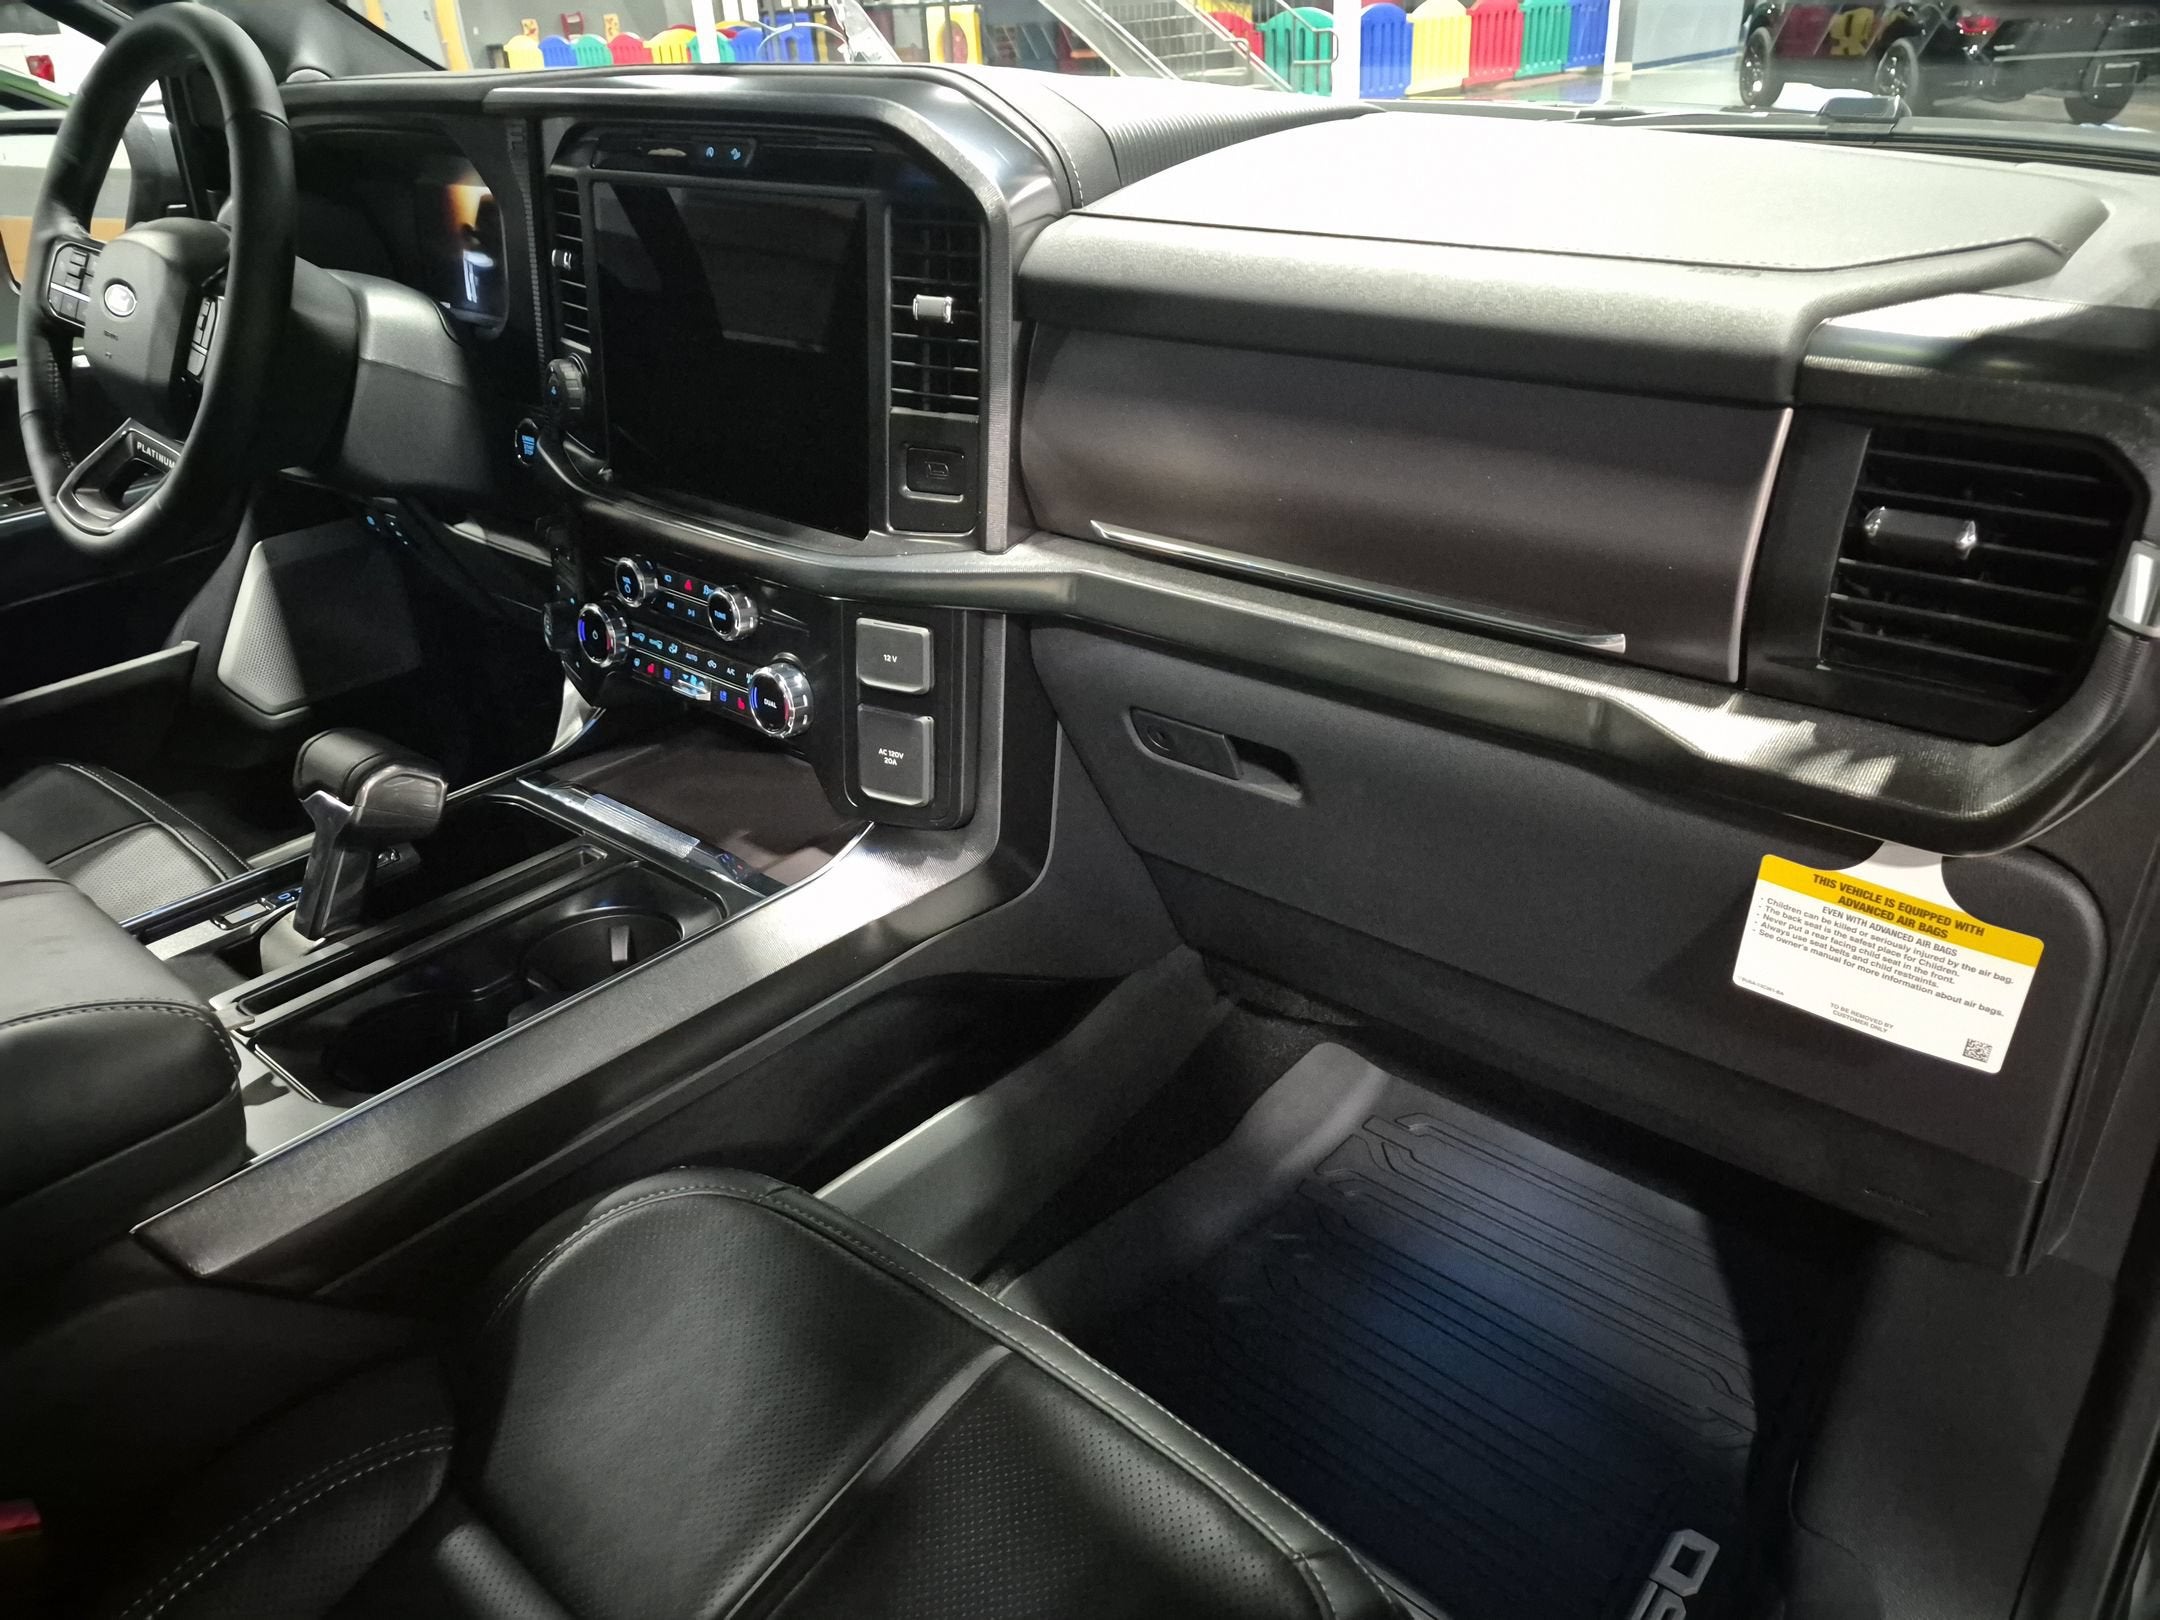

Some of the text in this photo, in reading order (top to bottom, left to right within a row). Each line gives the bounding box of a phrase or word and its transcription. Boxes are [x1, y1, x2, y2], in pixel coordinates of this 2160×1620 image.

[136, 441, 176, 469] PLATINUM
[883, 653, 892, 663] 12
[763, 697, 778, 709] DUAL
[878, 747, 905, 760] AC 120V
[883, 756, 898, 766] 20A
[1813, 874, 1985, 936] THIS VEHICLE IS EQUIPPED WITH
[1837, 896, 1948, 938] ADVANCED AIR BAGS
[1760, 922, 1790, 936] Always
[1792, 934, 1807, 942] use
[1809, 940, 1827, 949] seat
[1829, 945, 1849, 957] belts
[1851, 955, 1869, 964] and
[1870, 961, 1892, 972] child
[1763, 913, 1787, 926] Never
[1788, 924, 1802, 932] put
[1811, 932, 1829, 940] rear
[1830, 937, 1857, 952] facing
[1858, 948, 1880, 959] child
[1882, 956, 1901, 966] seat
[1903, 962, 1911, 970] in
[1913, 966, 1928, 975] the
[1765, 905, 1780, 915] The
[1782, 912, 1802, 923] back
[1804, 921, 1822, 930] seat
[1833, 930, 1847, 939] the
[1849, 936, 1876, 949] safest
[1877, 946, 1901, 957] place
[1903, 954, 1916, 962] for
[1767, 898, 1801, 915] Children
[1803, 912, 1819, 920] can
[1821, 916, 1831, 924] be
[1833, 921, 1857, 933] killed
[1870, 935, 1911, 952] seriously
[1913, 948, 1945, 963] injured
[1947, 959, 1959, 968] by
[1961, 963, 1976, 972] the
[1993, 973, 2013, 984] bag.
[1822, 906, 1957, 956] EVEN WITH ADVANCED AIR BAGS
[1759, 929, 1774, 939] See
[1810, 948, 1841, 963] manual
[1843, 959, 1855, 968] for
[1857, 965, 1880, 976] more
[1881, 973, 1933, 994] information
[1935, 992, 1962, 1003] about
